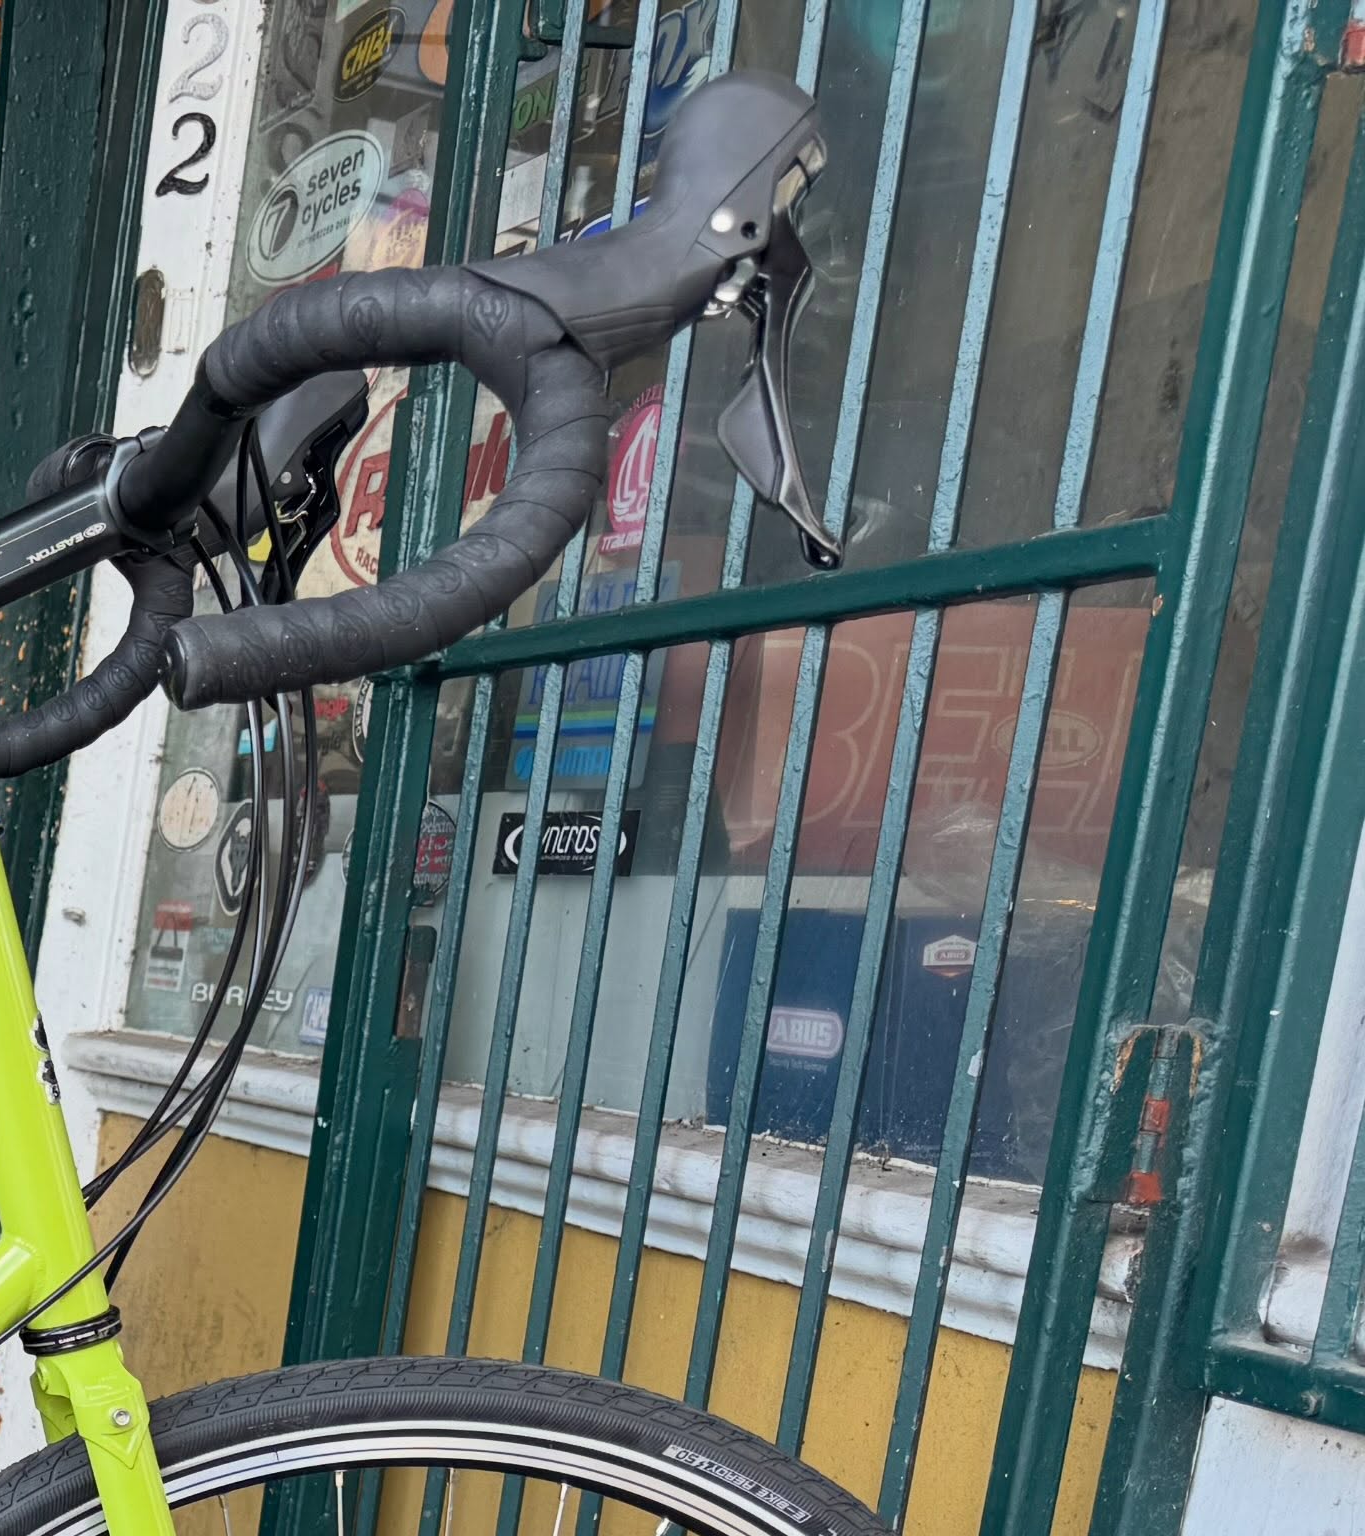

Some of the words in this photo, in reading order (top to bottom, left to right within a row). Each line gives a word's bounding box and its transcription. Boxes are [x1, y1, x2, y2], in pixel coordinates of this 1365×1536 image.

[306, 148, 366, 197] seven
[301, 178, 362, 232] cycles
[26, 531, 85, 565] EASTON
[542, 825, 601, 854] NCROS
[191, 981, 294, 1012] BREY
[775, 1017, 832, 1049] ABUS
[705, 1462, 758, 1493] READY
[757, 1488, 812, 1525] E-BIKE
